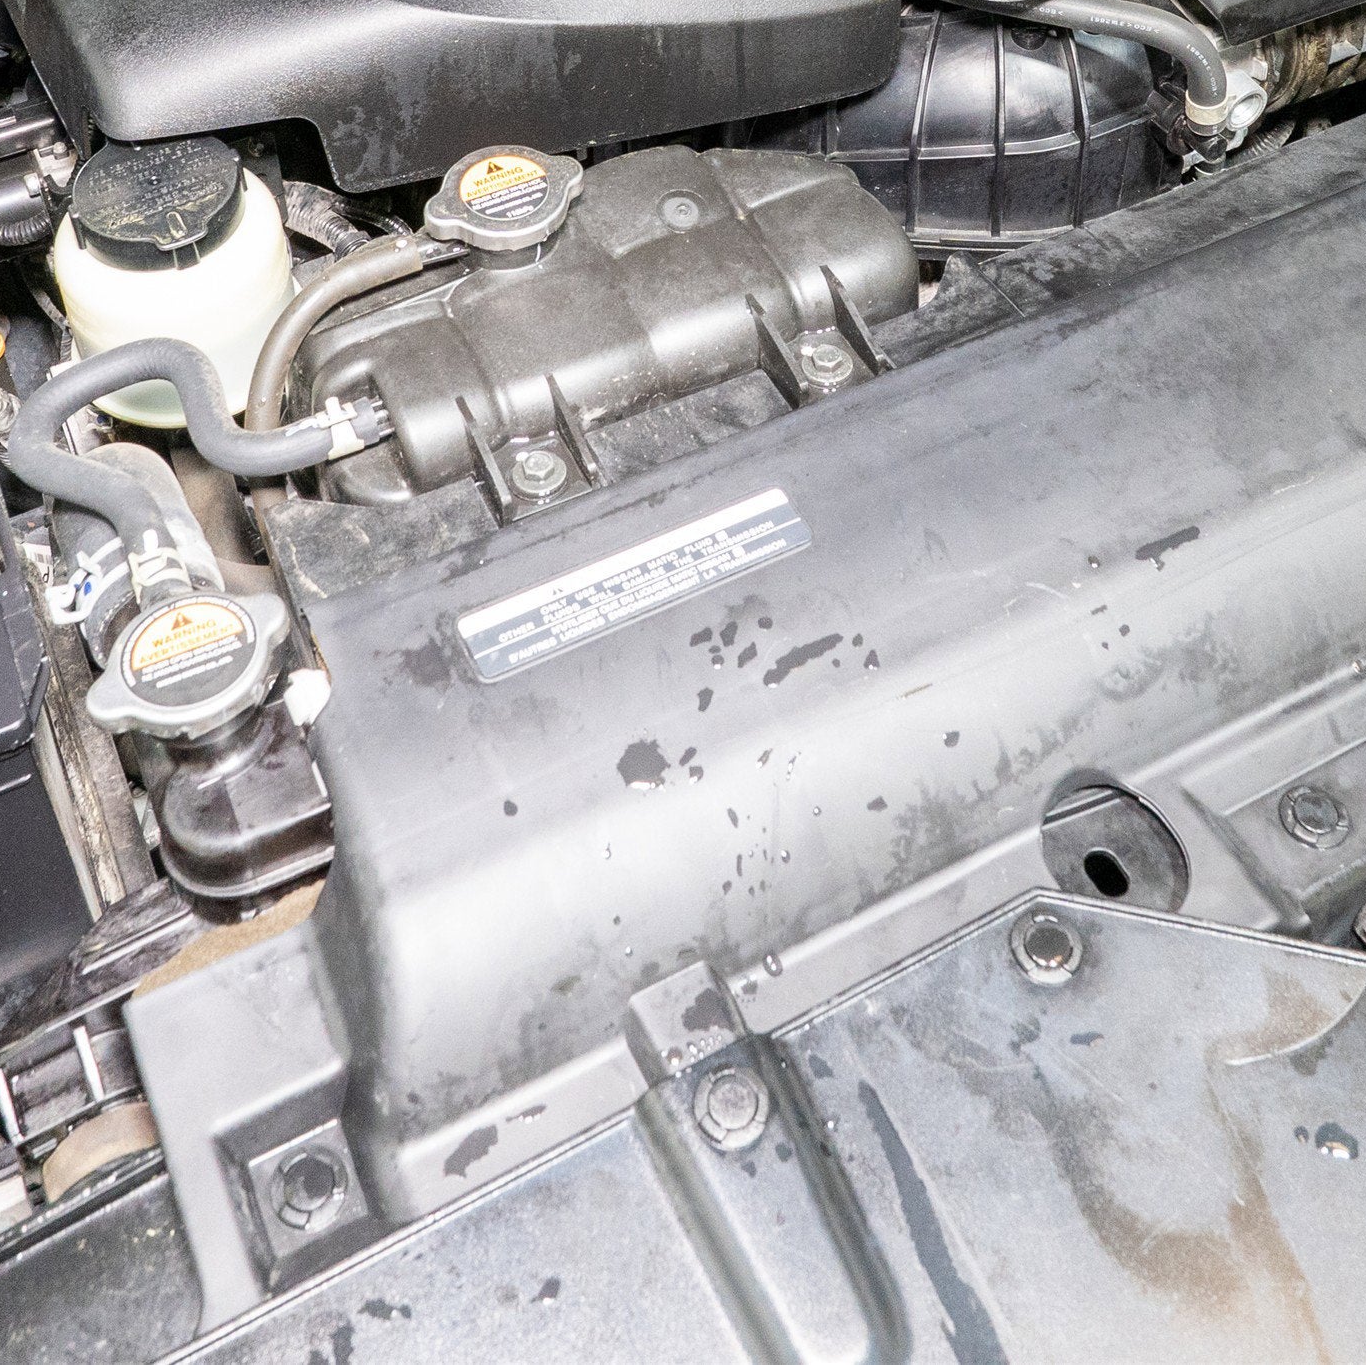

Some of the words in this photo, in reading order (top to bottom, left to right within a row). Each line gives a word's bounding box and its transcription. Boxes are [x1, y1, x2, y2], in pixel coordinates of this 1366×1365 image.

[466, 169, 539, 198] AVERTISSEMENT
[473, 166, 524, 188] WARNING
[539, 597, 567, 616] ONLY
[602, 567, 642, 589] NISSAN
[646, 551, 679, 571] MATIC
[683, 537, 713, 555] FLUID
[498, 621, 536, 643] OTHER
[587, 588, 615, 605] WILL
[621, 566, 666, 591] DAMAGE
[672, 553, 695, 568] THE
[152, 621, 217, 648] WARNING
